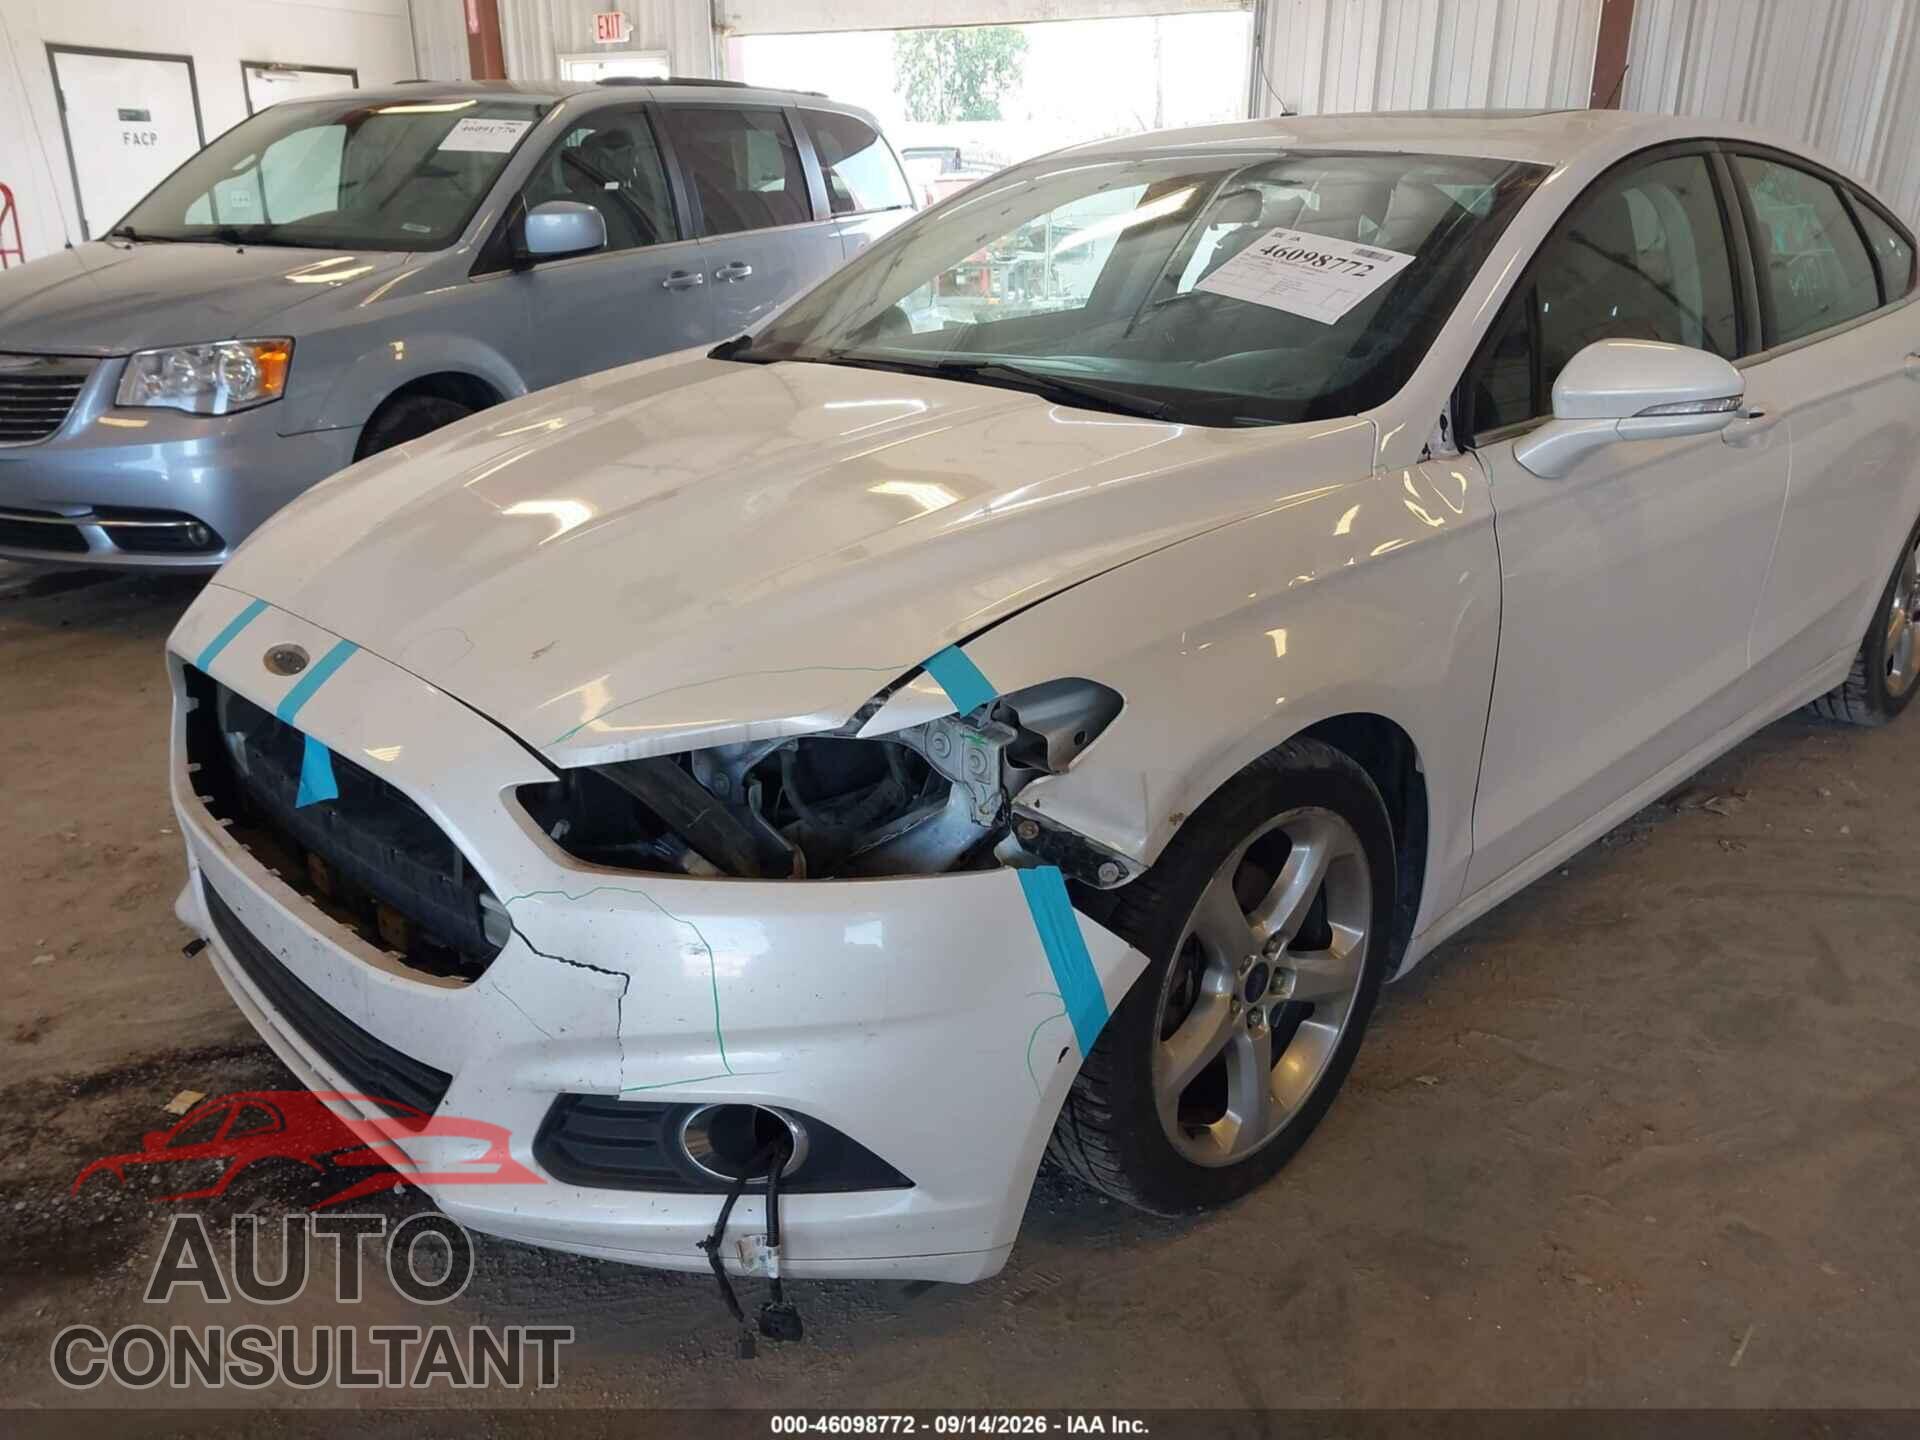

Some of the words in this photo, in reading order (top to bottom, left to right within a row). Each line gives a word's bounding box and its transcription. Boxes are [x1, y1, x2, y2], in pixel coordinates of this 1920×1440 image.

[597, 14, 621, 39] EXIT
[123, 131, 158, 146] FACP
[1260, 244, 1375, 277] 46098772
